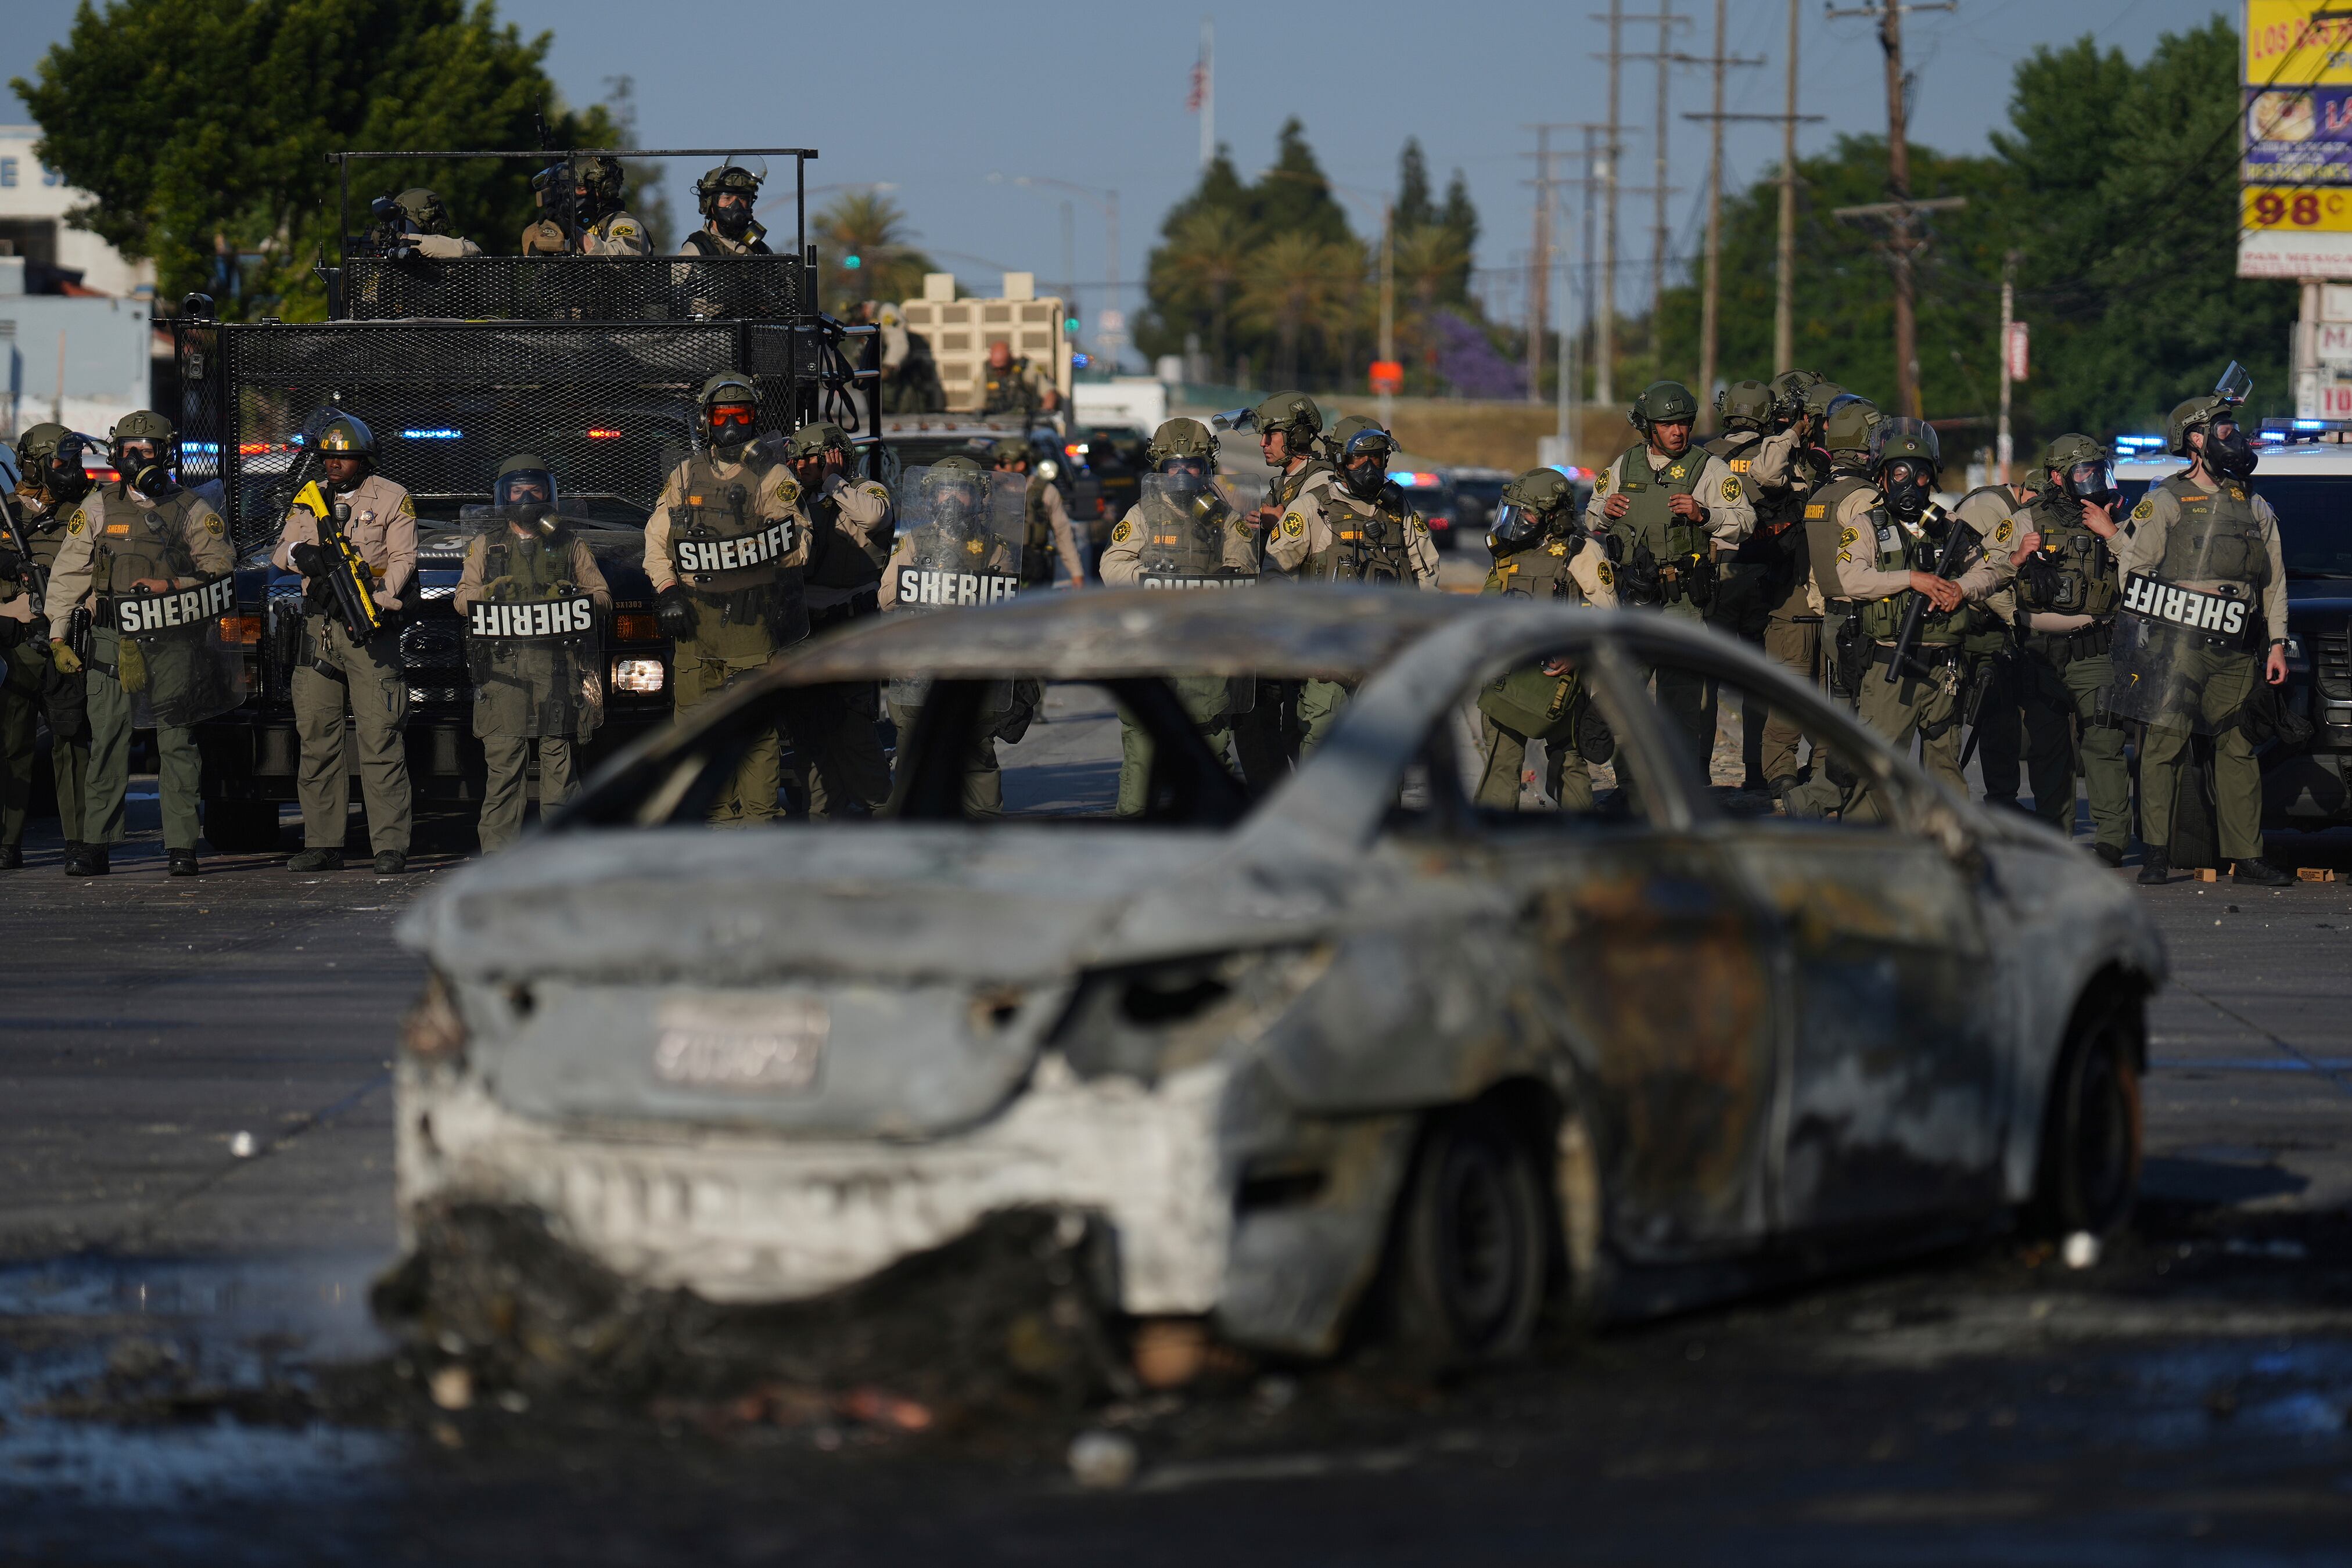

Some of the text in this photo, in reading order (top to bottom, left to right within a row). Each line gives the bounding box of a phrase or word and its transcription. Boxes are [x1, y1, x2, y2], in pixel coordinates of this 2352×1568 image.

[2254, 21, 2288, 59] LOS
[2256, 192, 2320, 225] 98
[107, 524, 130, 533] SHERIFF
[678, 520, 793, 570] SHERIFF
[1340, 531, 1363, 540] SHEIF
[120, 576, 233, 632] SHERIFF
[900, 570, 1017, 607] SHERIFF
[2124, 577, 2245, 634] SHERIFF
[472, 598, 591, 636] SHERIFF
